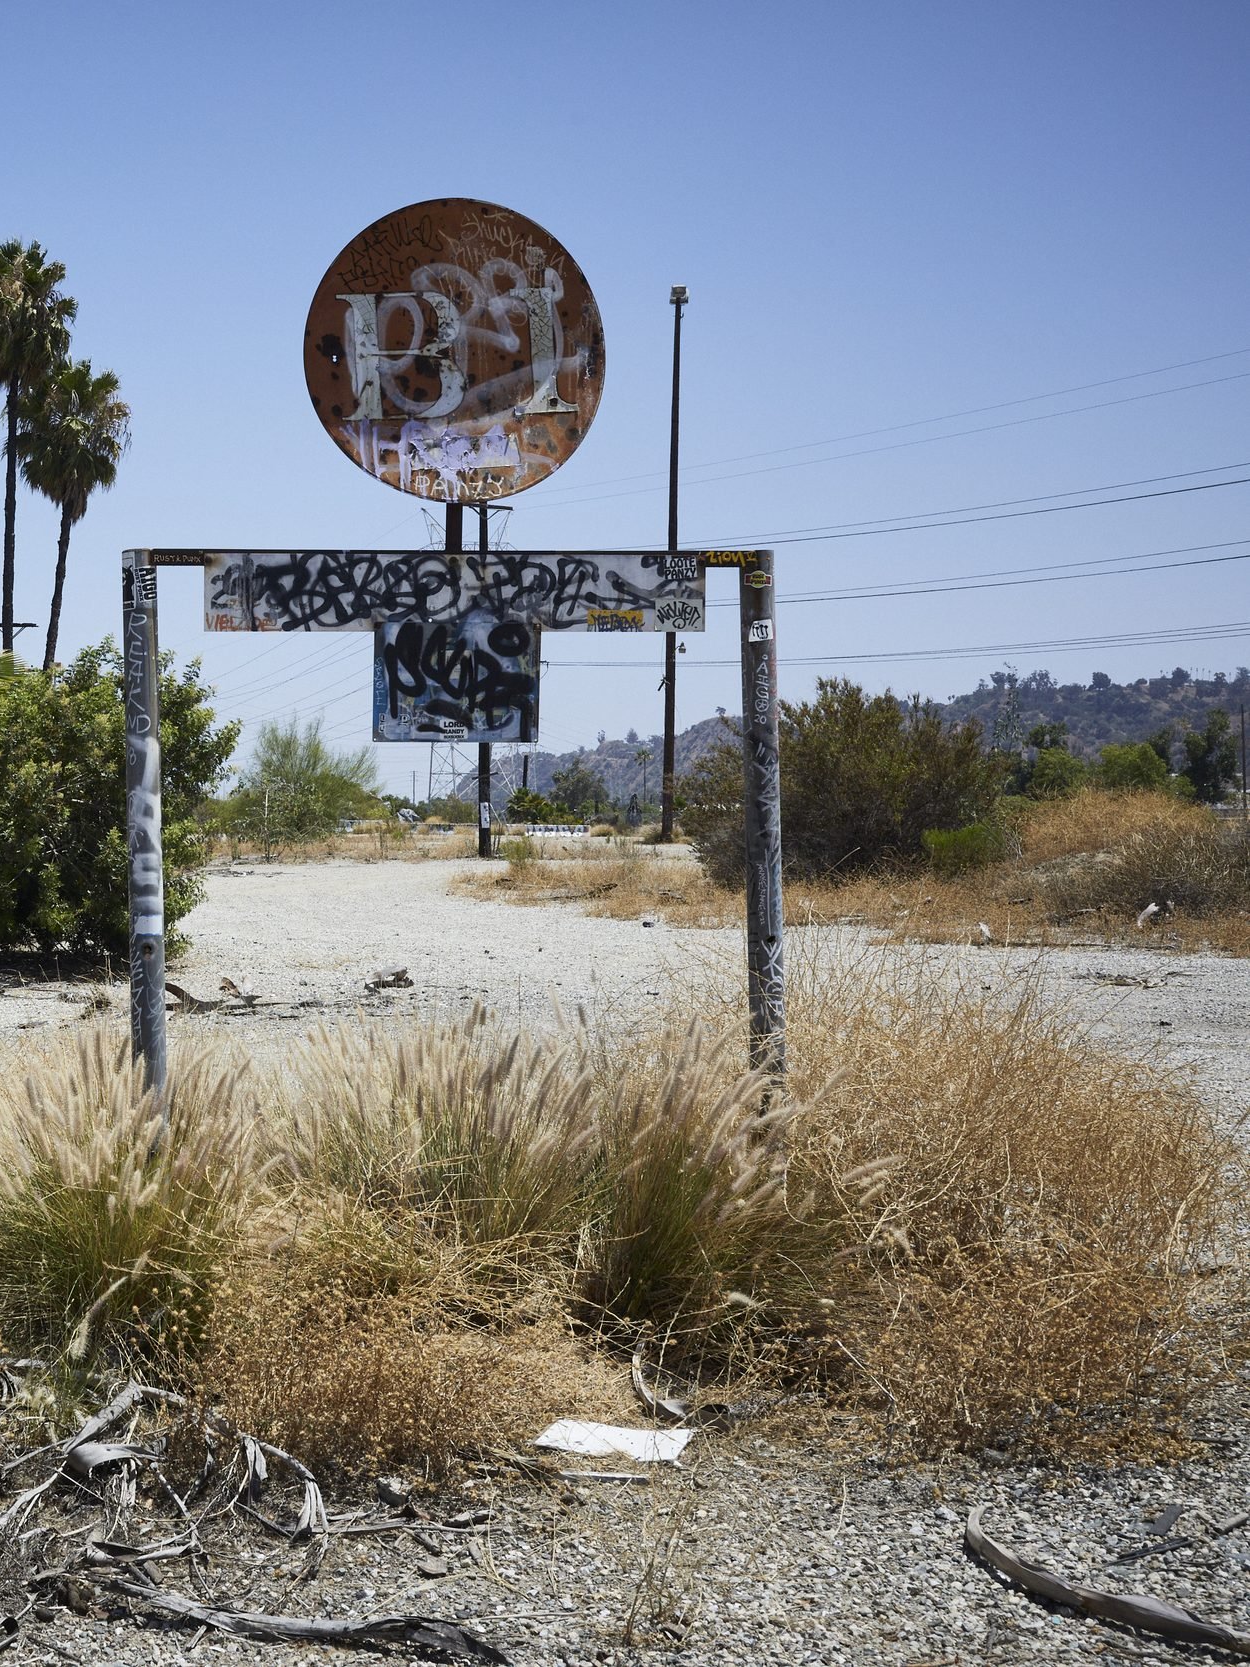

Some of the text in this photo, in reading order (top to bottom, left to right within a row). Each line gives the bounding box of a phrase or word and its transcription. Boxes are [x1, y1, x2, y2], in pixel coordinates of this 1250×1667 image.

[664, 557, 696, 569] LOOTE
[664, 568, 696, 580] PANZY
[139, 568, 157, 600] AIGO
